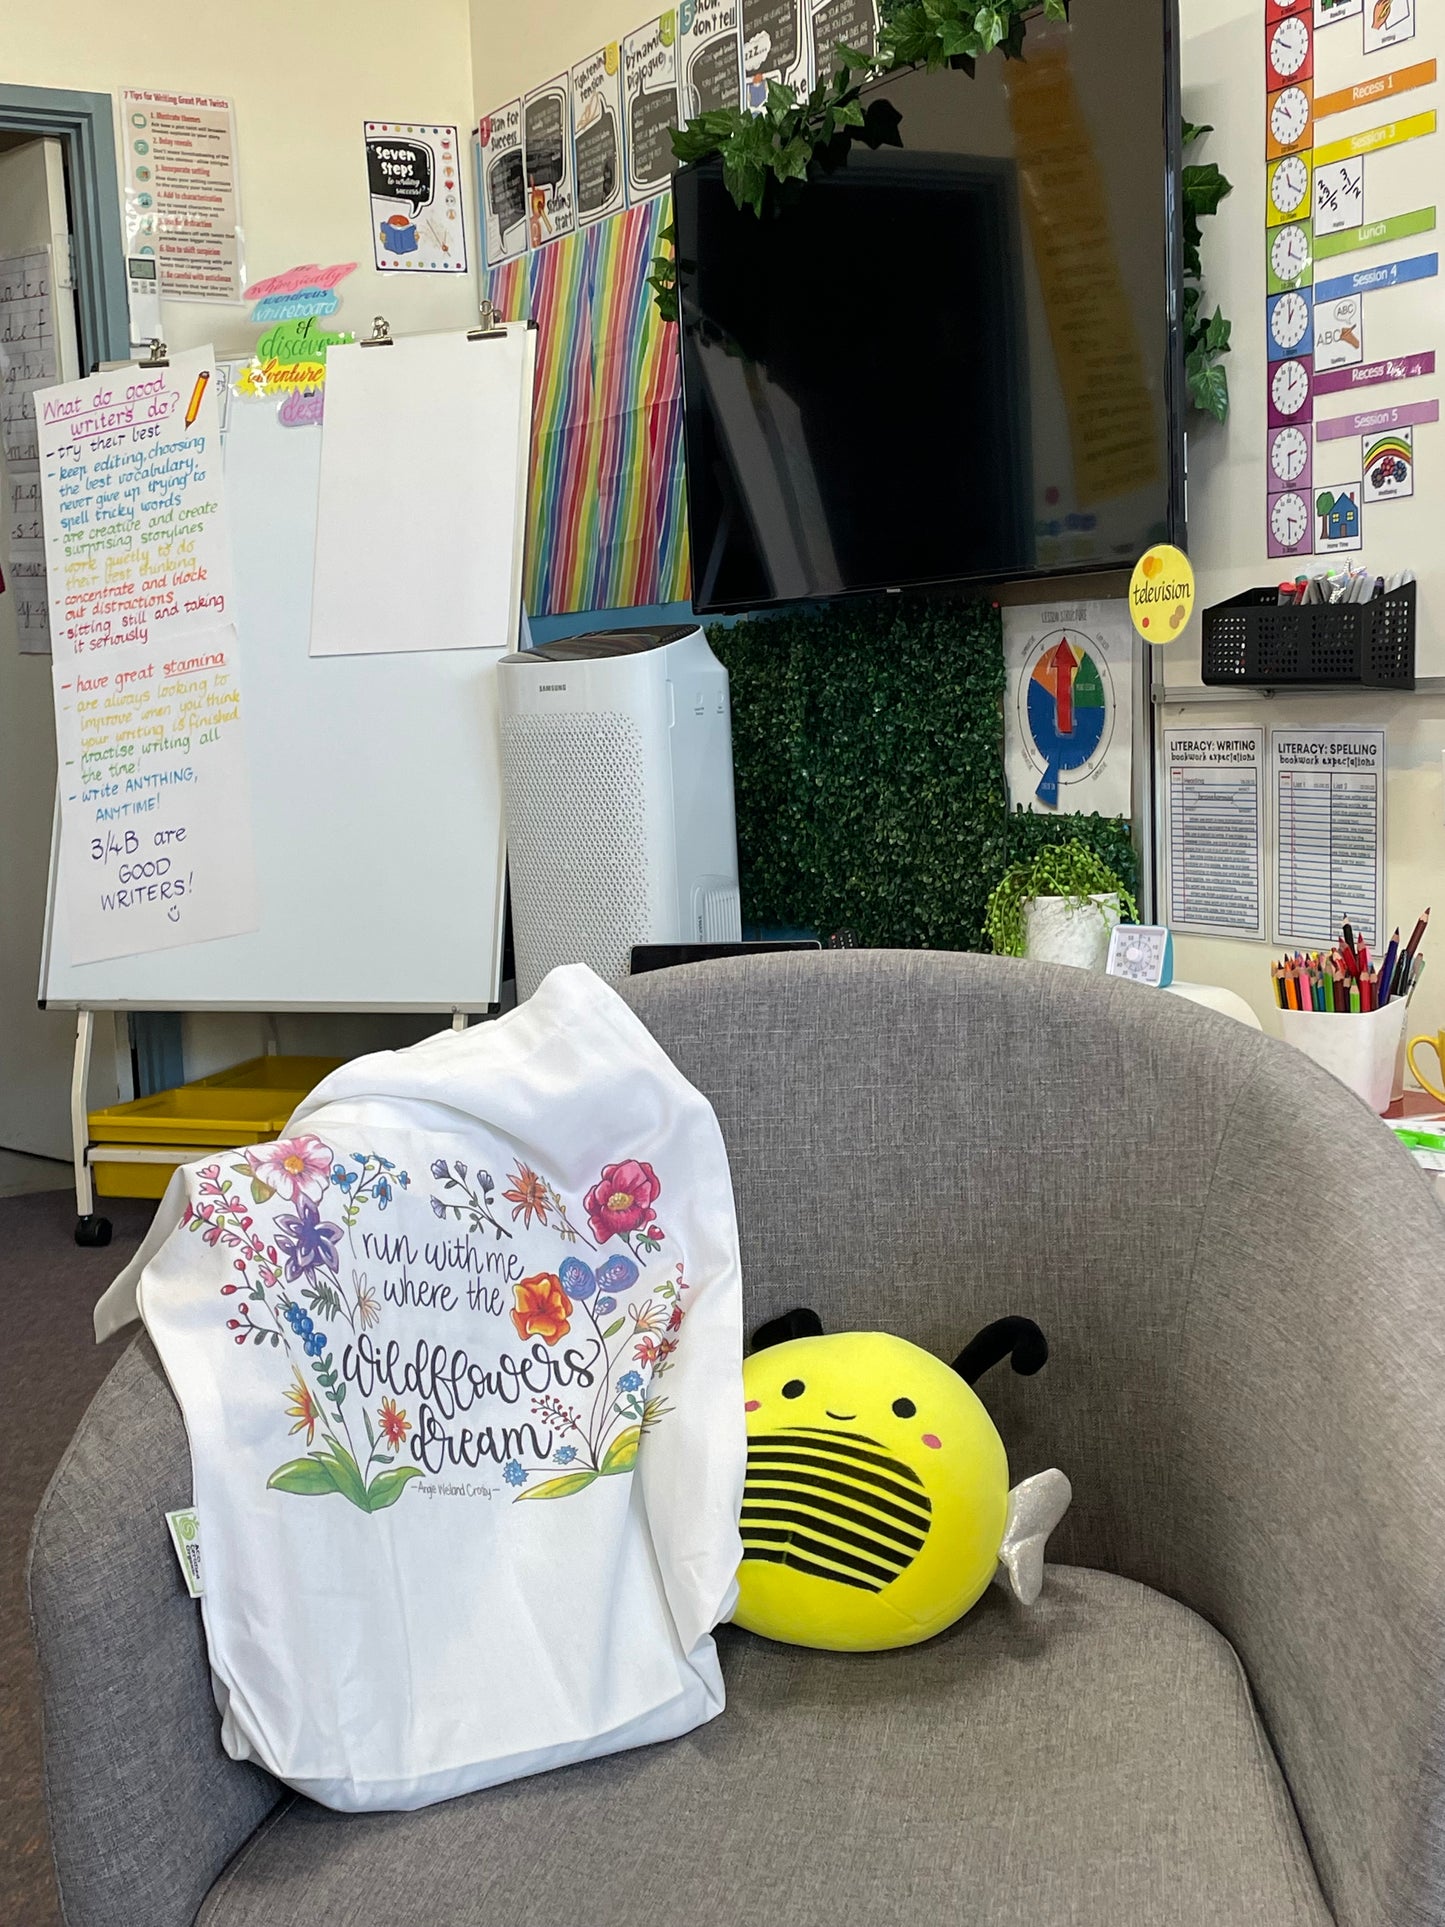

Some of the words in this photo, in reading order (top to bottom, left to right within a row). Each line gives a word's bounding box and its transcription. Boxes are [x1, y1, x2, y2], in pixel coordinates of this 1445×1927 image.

[719, 7, 735, 29] tell
[1352, 81, 1384, 100] Recess
[1387, 75, 1394, 89] 1
[507, 112, 518, 128] for
[1351, 129, 1386, 150] Session
[1388, 124, 1396, 137] 3
[376, 146, 416, 162] Seven
[381, 162, 414, 178] Steps
[1358, 224, 1386, 241] Lunch
[1353, 270, 1388, 287] Session
[1390, 264, 1398, 277] 4
[1336, 304, 1354, 316] ABC
[296, 316, 316, 339] of
[1352, 366, 1384, 382] Recess
[43, 397, 82, 420] What
[92, 388, 112, 408] do
[126, 372, 166, 411] good
[70, 409, 134, 436] writers
[148, 392, 180, 418] do?
[1354, 412, 1390, 429] Session
[1392, 408, 1398, 420] 5
[132, 424, 161, 443] best
[58, 484, 80, 498] the
[86, 476, 112, 492] best
[59, 466, 88, 482] keep
[60, 496, 93, 513] never
[96, 491, 120, 509] give
[124, 487, 140, 502] up
[148, 474, 188, 496] trying
[193, 470, 206, 482] to
[60, 511, 90, 532] spell
[95, 504, 135, 522] tricky
[140, 494, 182, 512] words
[63, 531, 84, 545] are
[88, 520, 141, 540] creative
[148, 508, 174, 528] and
[178, 500, 218, 522] create
[64, 534, 133, 560] surprising
[140, 522, 204, 545] storylines
[177, 538, 196, 554] do
[64, 582, 136, 606] concentrate
[142, 575, 167, 592] and
[172, 566, 208, 586] block
[1132, 579, 1192, 606] television
[92, 591, 175, 616] distractions
[122, 610, 147, 628] still
[154, 604, 180, 620] and
[184, 593, 225, 614] taking
[74, 640, 85, 655] it
[89, 626, 149, 651] seriously
[76, 674, 109, 694] have
[114, 663, 154, 694] great
[163, 651, 226, 676] stamina
[76, 700, 98, 714] are
[104, 690, 150, 710] always
[157, 679, 208, 699] looking
[214, 673, 230, 686] to
[539, 684, 567, 693] SAMSUNG
[80, 711, 133, 733] improve
[206, 688, 240, 707] think
[81, 735, 110, 753] your
[116, 723, 164, 742] writing
[172, 716, 186, 733] is
[188, 706, 240, 733] finished
[80, 744, 135, 770] practise
[141, 734, 191, 756] writing
[199, 726, 222, 746] all
[1170, 740, 1215, 752] LITERACY:
[1216, 740, 1256, 751] WRITING
[1171, 752, 1206, 761] bookwork
[1208, 753, 1256, 763] expectations
[1278, 743, 1328, 754] LITERACY:
[1330, 744, 1377, 756] SPELLING
[1280, 755, 1320, 765] bookwork
[1322, 756, 1376, 768] expectations
[81, 767, 104, 785] the
[82, 782, 120, 804] write
[124, 766, 198, 793] ANYTHING,
[96, 792, 161, 823] ANYTIME!
[90, 829, 140, 865] 3/4B
[153, 826, 188, 846] are
[118, 857, 172, 884] GOOD
[100, 871, 194, 913] WRITERS!
[362, 1233, 418, 1265] run
[424, 1234, 485, 1274] with
[486, 1249, 525, 1283] me
[383, 1264, 459, 1312] where
[466, 1276, 505, 1317] the
[342, 1333, 602, 1421] wildflowers
[410, 1403, 553, 1475] dream
